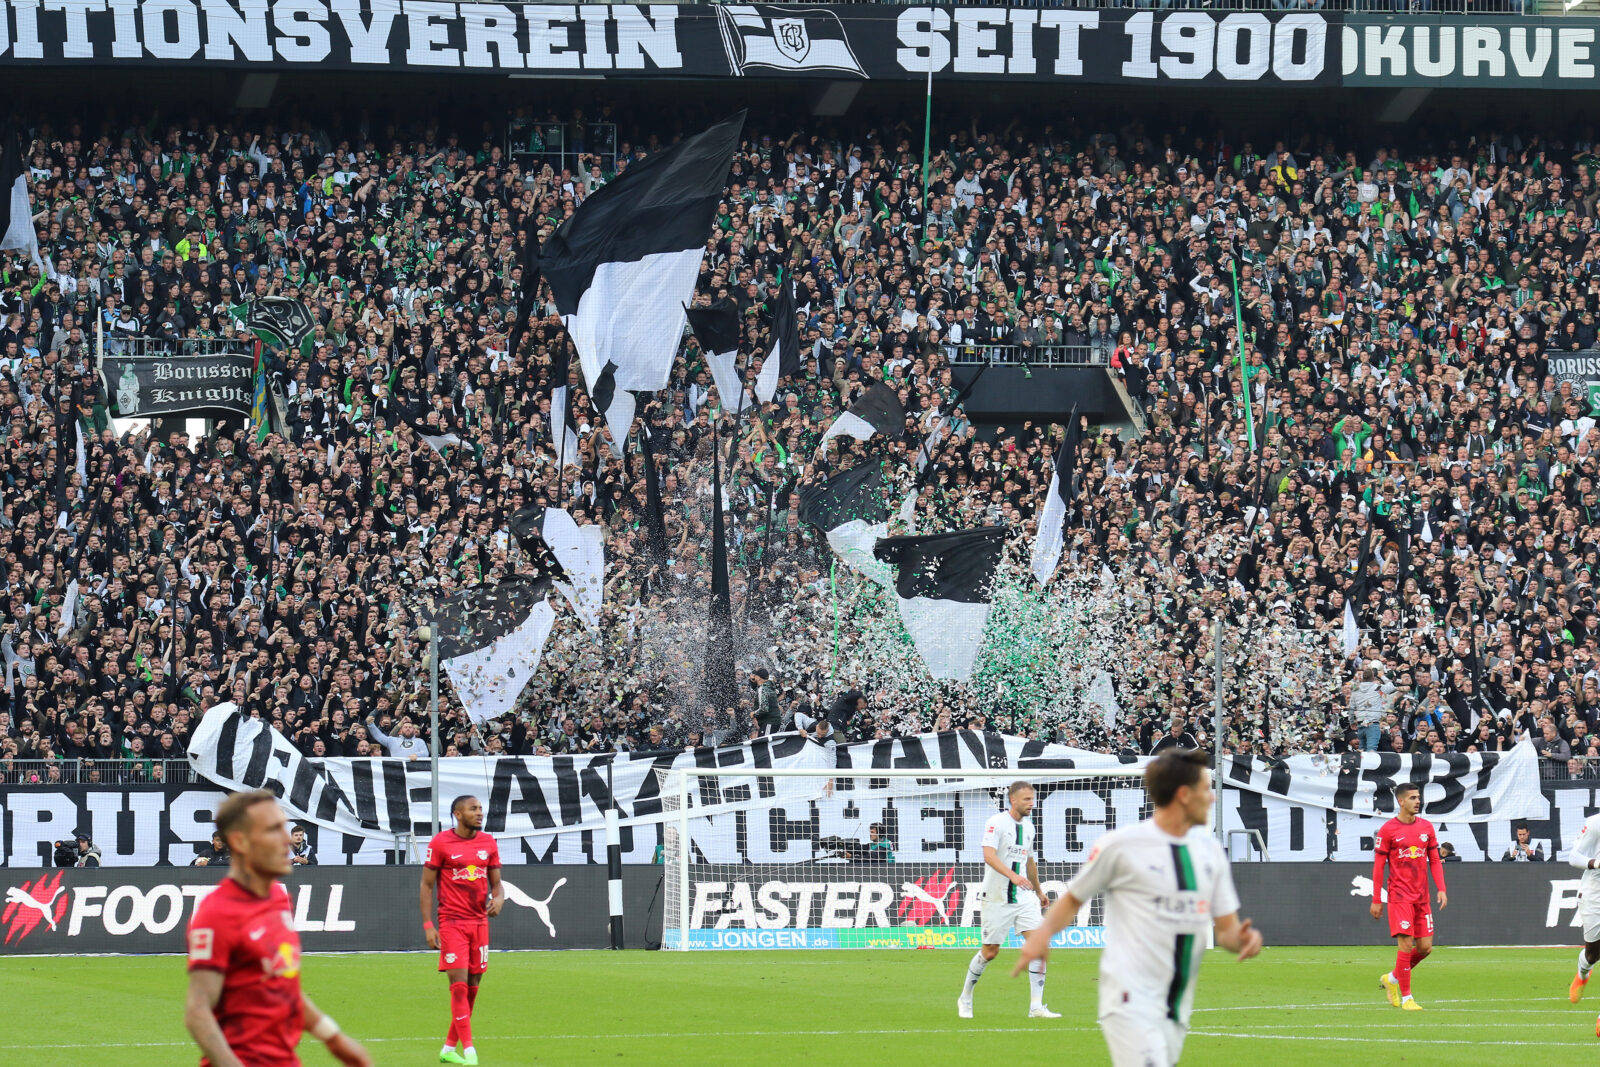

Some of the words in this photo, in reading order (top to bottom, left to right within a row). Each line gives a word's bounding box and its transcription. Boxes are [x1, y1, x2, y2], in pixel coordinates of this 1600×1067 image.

[0, 0, 683, 68] ITIONSVEREIN
[896, 7, 1099, 76] SEIT
[1122, 11, 1327, 81] 1900
[152, 362, 252, 383] Borussen
[150, 386, 252, 405] Knights
[67, 884, 356, 936] FOOTLL
[690, 880, 894, 929] FASTER
[711, 931, 807, 948] JONGEN
